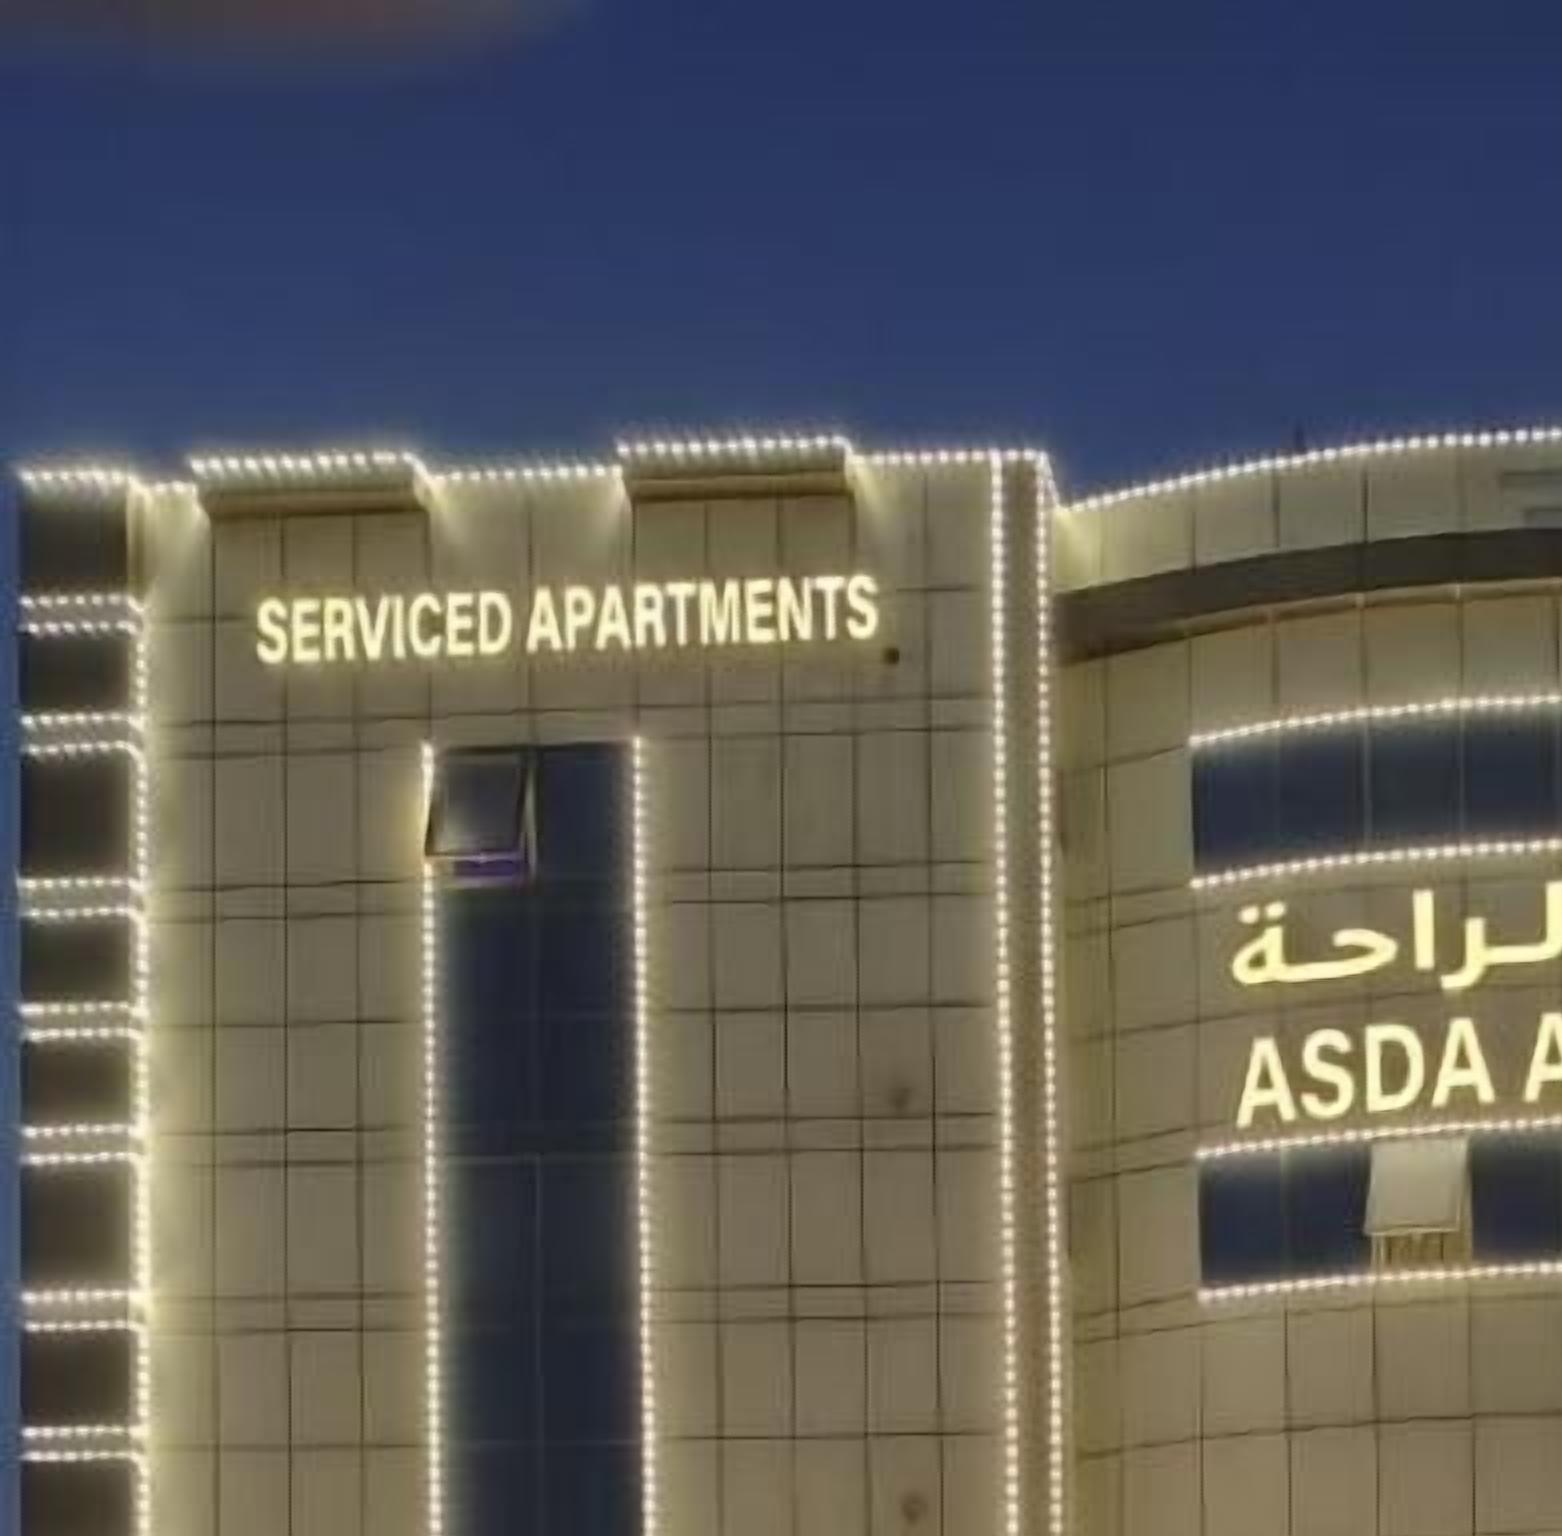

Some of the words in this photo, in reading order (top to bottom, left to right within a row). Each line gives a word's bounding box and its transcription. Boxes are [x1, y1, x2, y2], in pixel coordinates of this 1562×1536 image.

[256, 590, 513, 664] SERVICED
[526, 573, 879, 652] APARTMENTS
[1235, 1017, 1495, 1128] ASDA
